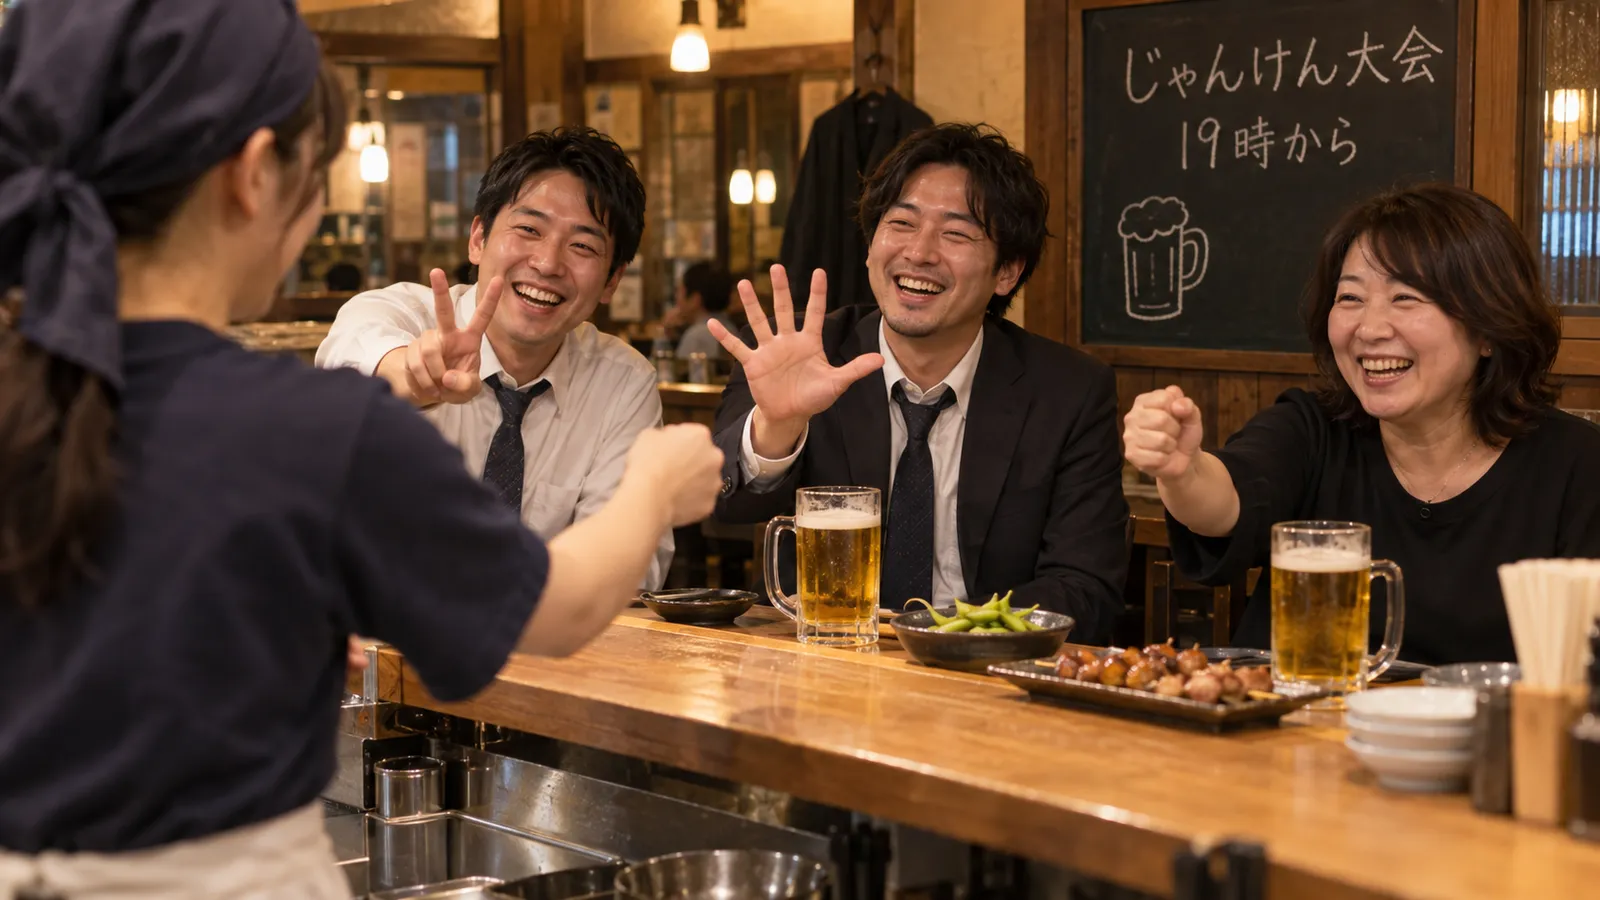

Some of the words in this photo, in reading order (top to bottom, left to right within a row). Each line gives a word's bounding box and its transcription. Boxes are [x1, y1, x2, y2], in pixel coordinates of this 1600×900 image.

[1126, 25, 1443, 103] じゃんけん大会
[1182, 116, 1357, 170] 19時から
